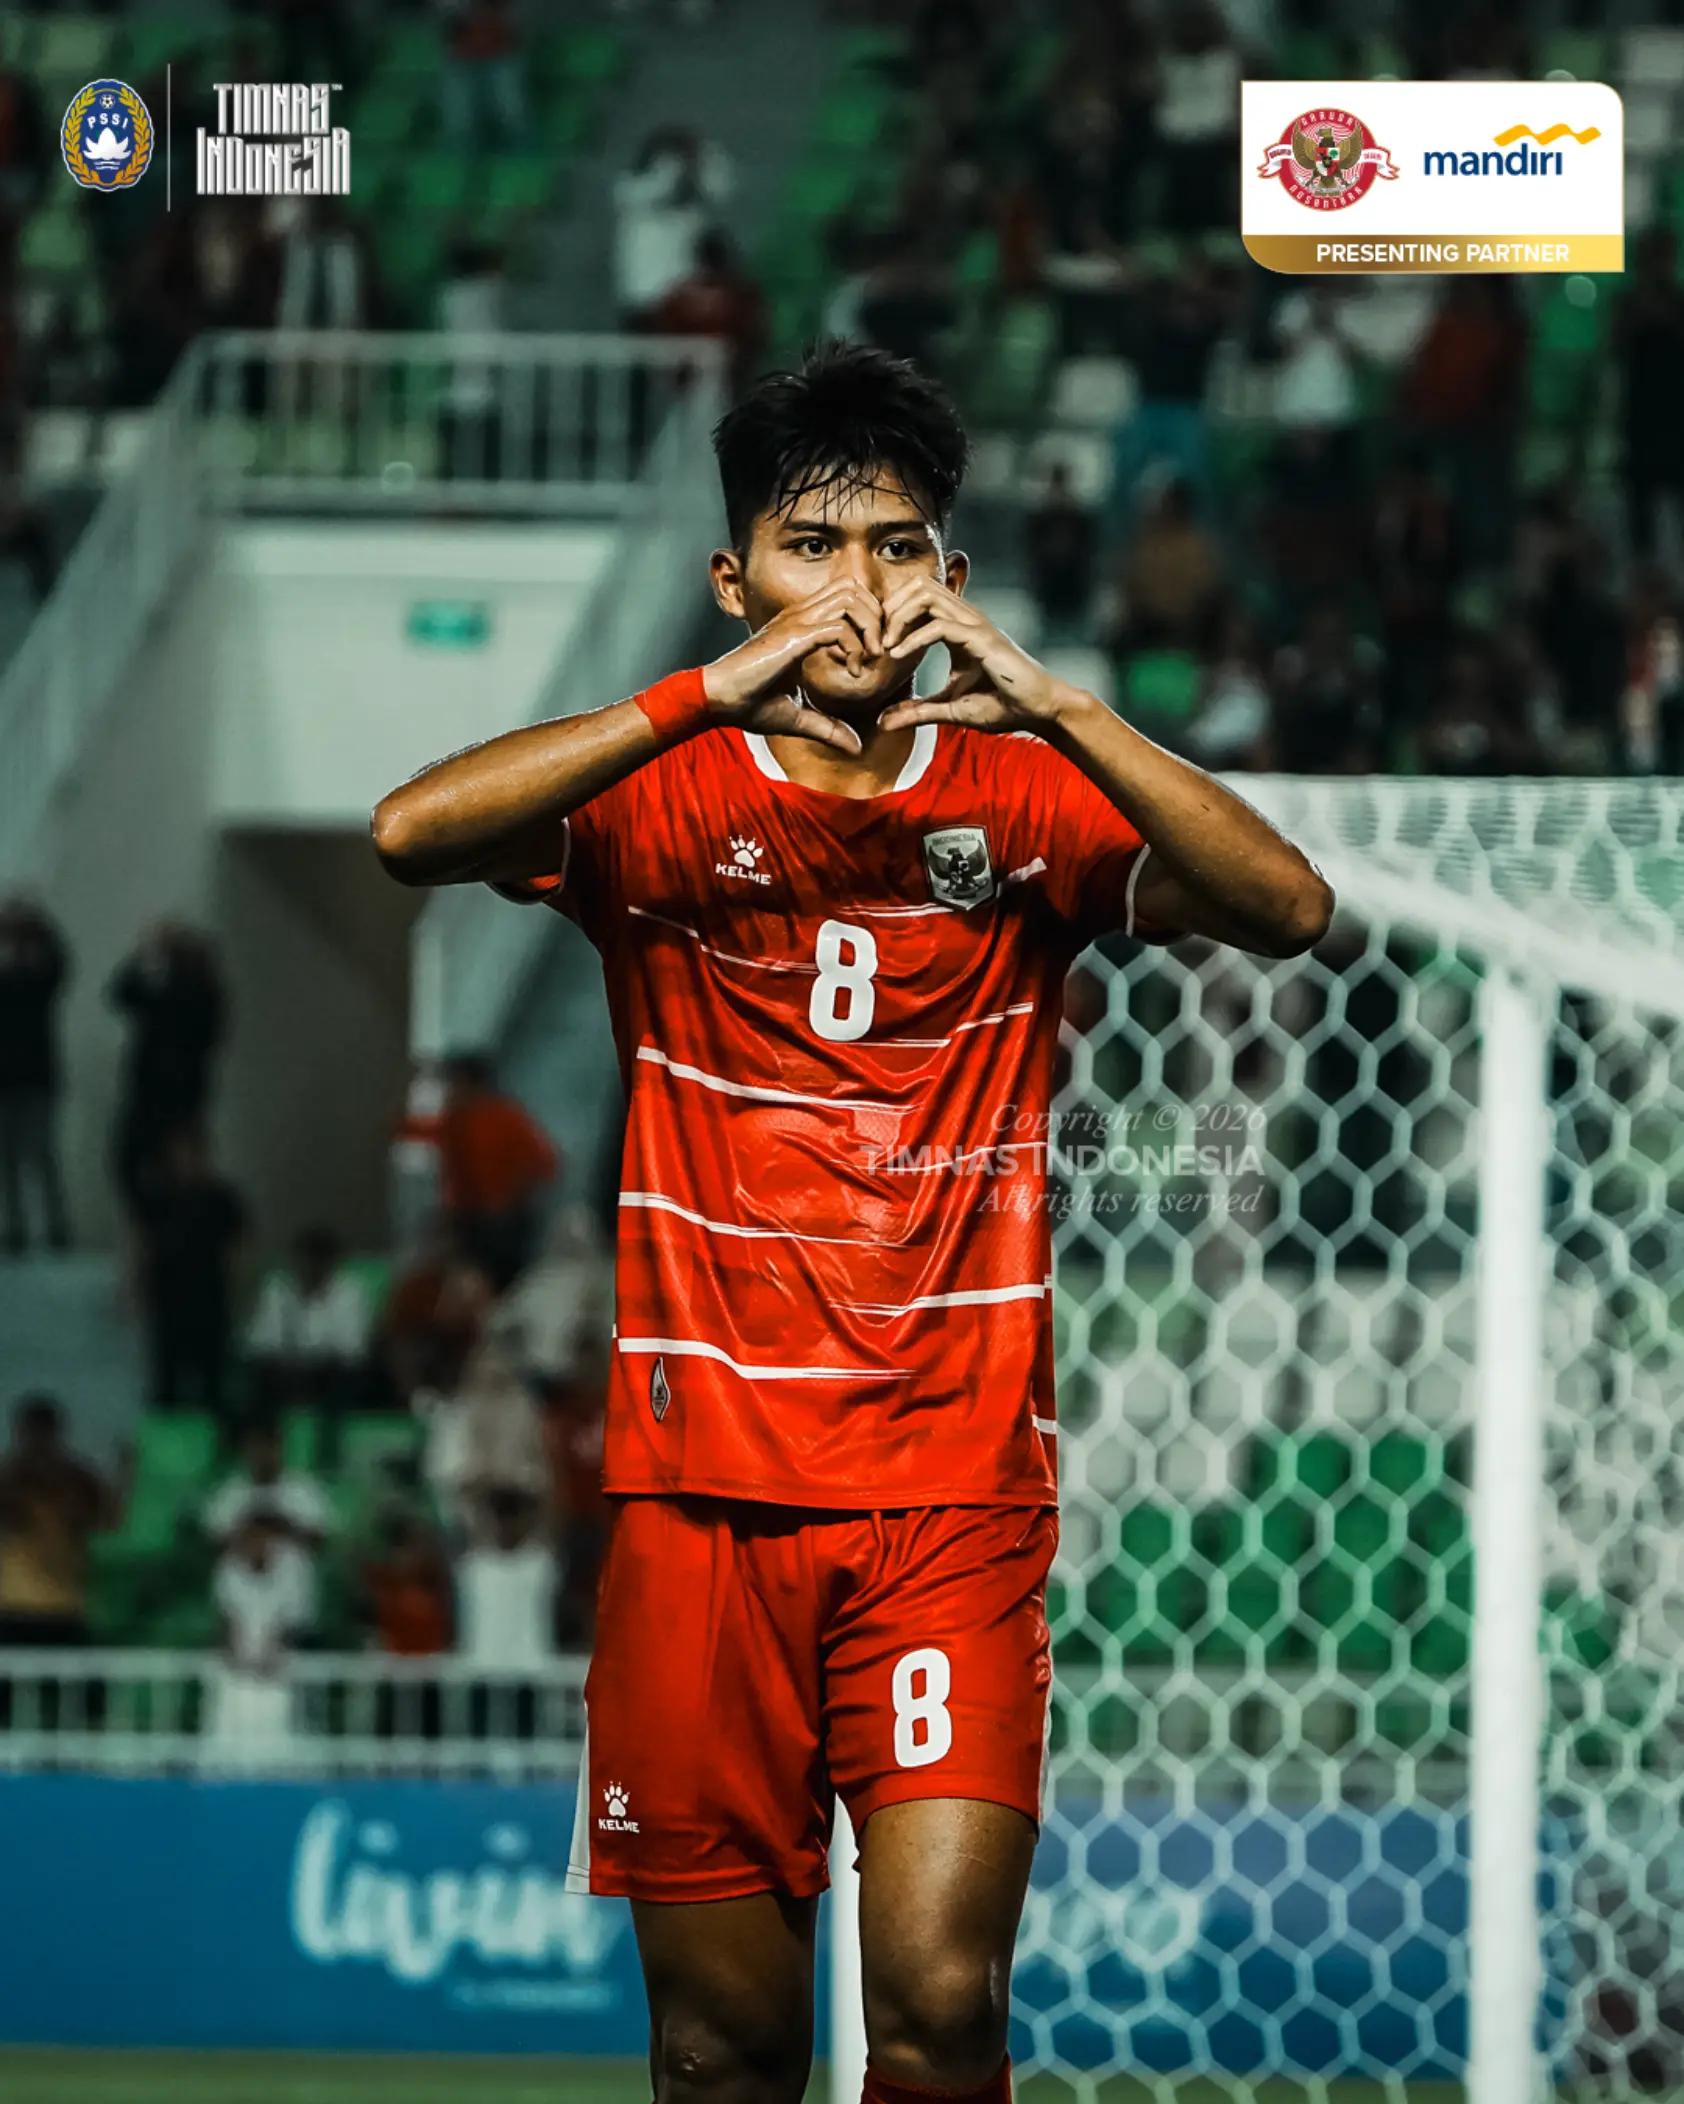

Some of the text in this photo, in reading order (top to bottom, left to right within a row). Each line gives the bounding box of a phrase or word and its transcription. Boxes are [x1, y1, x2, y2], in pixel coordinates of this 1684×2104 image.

[715, 862, 771, 886] KELME
[809, 919, 878, 1042] 8
[892, 1648, 953, 1769] 8
[598, 1818, 640, 1834] KELME
